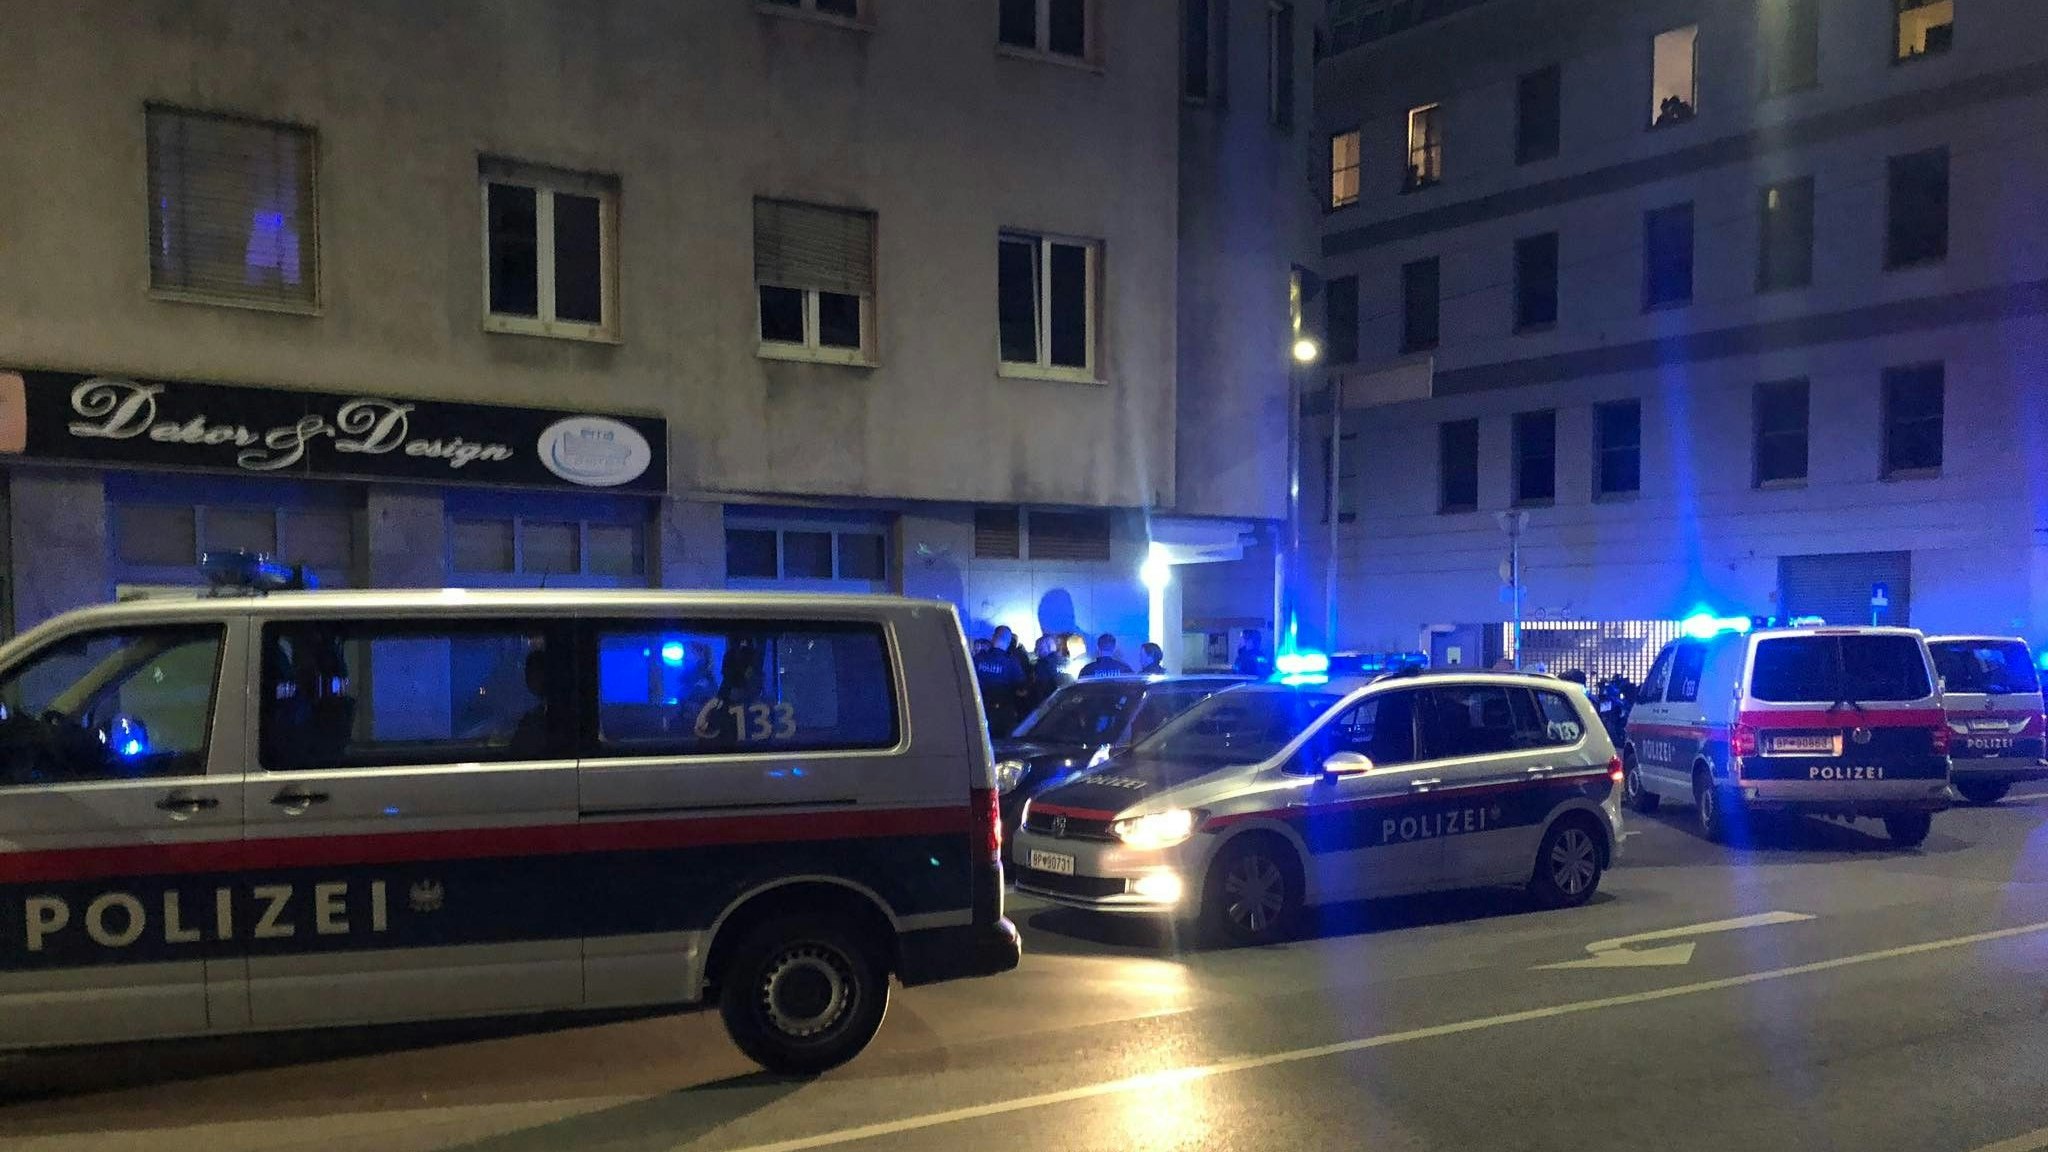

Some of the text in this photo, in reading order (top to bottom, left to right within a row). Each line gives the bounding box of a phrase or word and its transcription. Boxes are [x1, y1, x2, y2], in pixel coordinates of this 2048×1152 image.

[68, 377, 515, 471] Dekor & Design
[728, 703, 797, 741] 133
[1966, 738, 2013, 749] POLIZEI
[1808, 766, 1884, 781] POLIZEI
[1382, 806, 1488, 844] POLIZEI
[25, 880, 388, 951] POLIZEI
